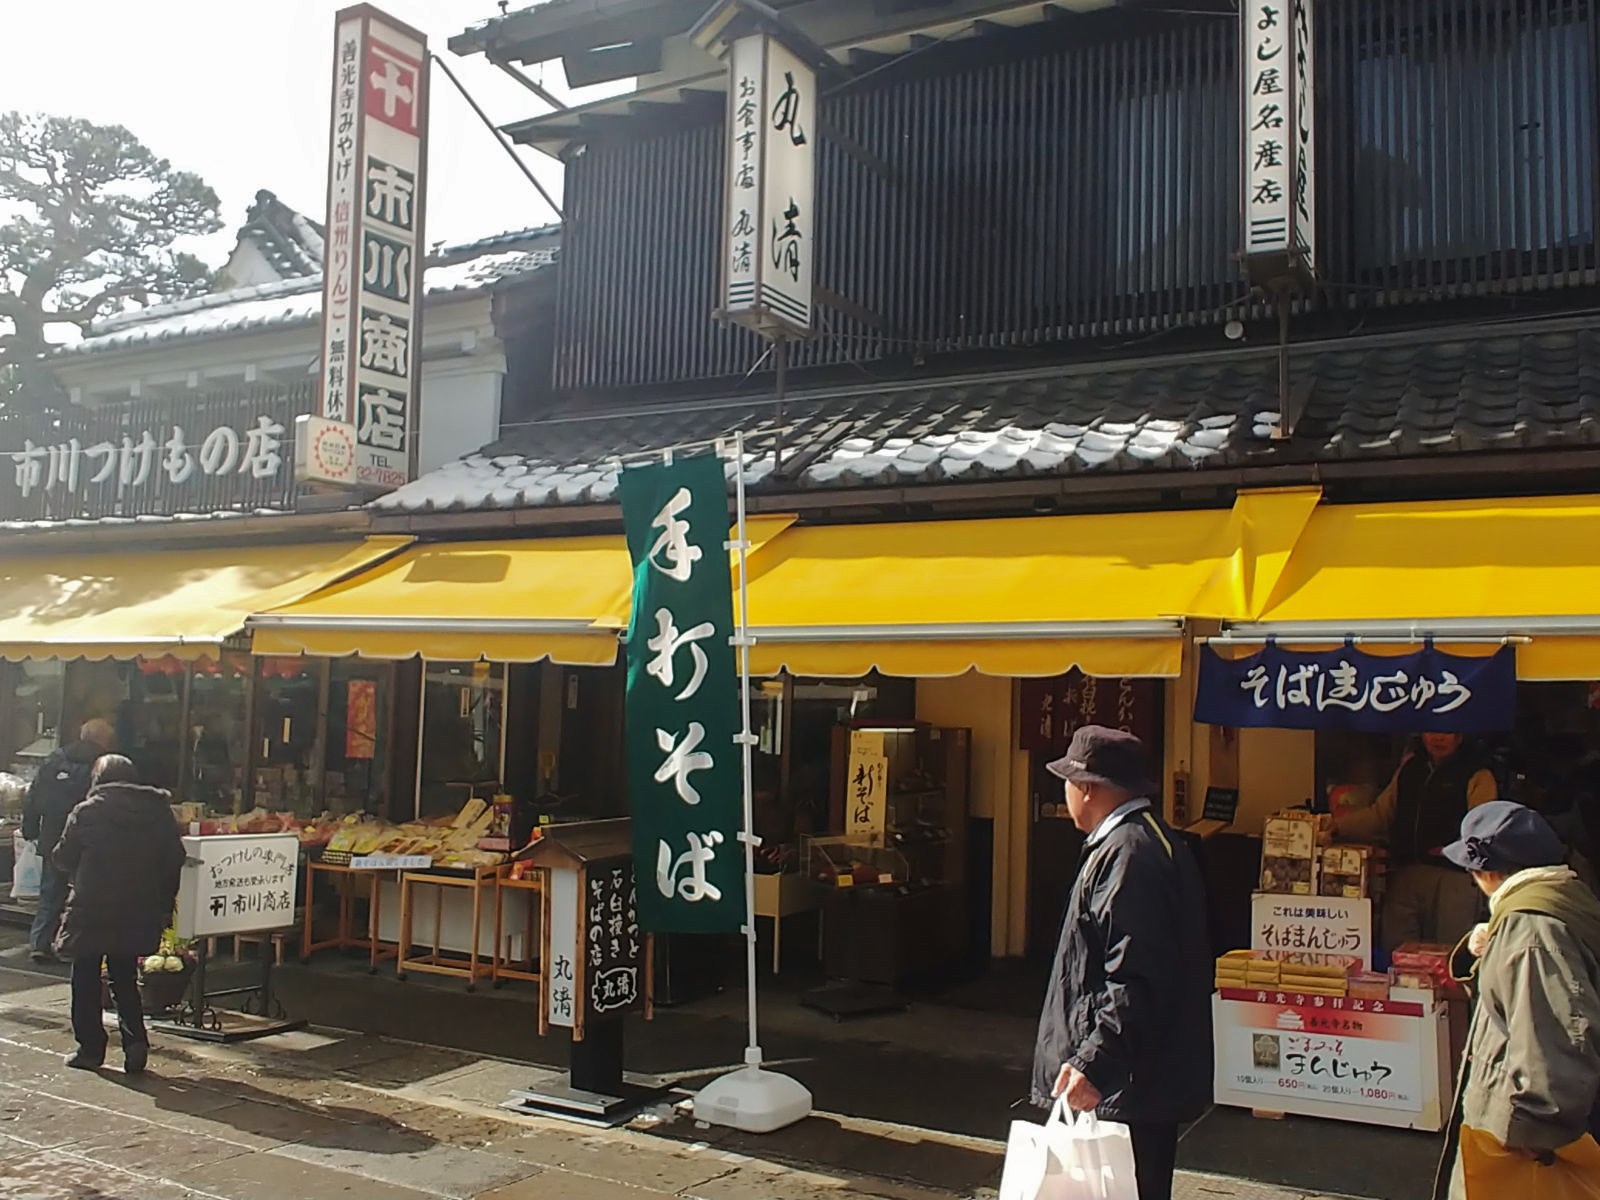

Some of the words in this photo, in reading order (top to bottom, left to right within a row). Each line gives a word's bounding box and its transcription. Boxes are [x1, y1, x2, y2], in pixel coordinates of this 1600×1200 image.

[359, 165, 414, 447] 市川商店
[11, 414, 286, 498] 市川つけもの店
[646, 487, 724, 902] 手打そば
[852, 763, 874, 823] 新そば
[231, 890, 290, 915] 市川商店
[589, 879, 604, 967] そばの店
[1273, 906, 1348, 919] これは美味しい
[1261, 923, 1361, 950] そばまんじゅう
[553, 955, 573, 1018] 丸清
[603, 973, 630, 1000] 丸清
[1286, 1053, 1392, 1085] まんじゅう
